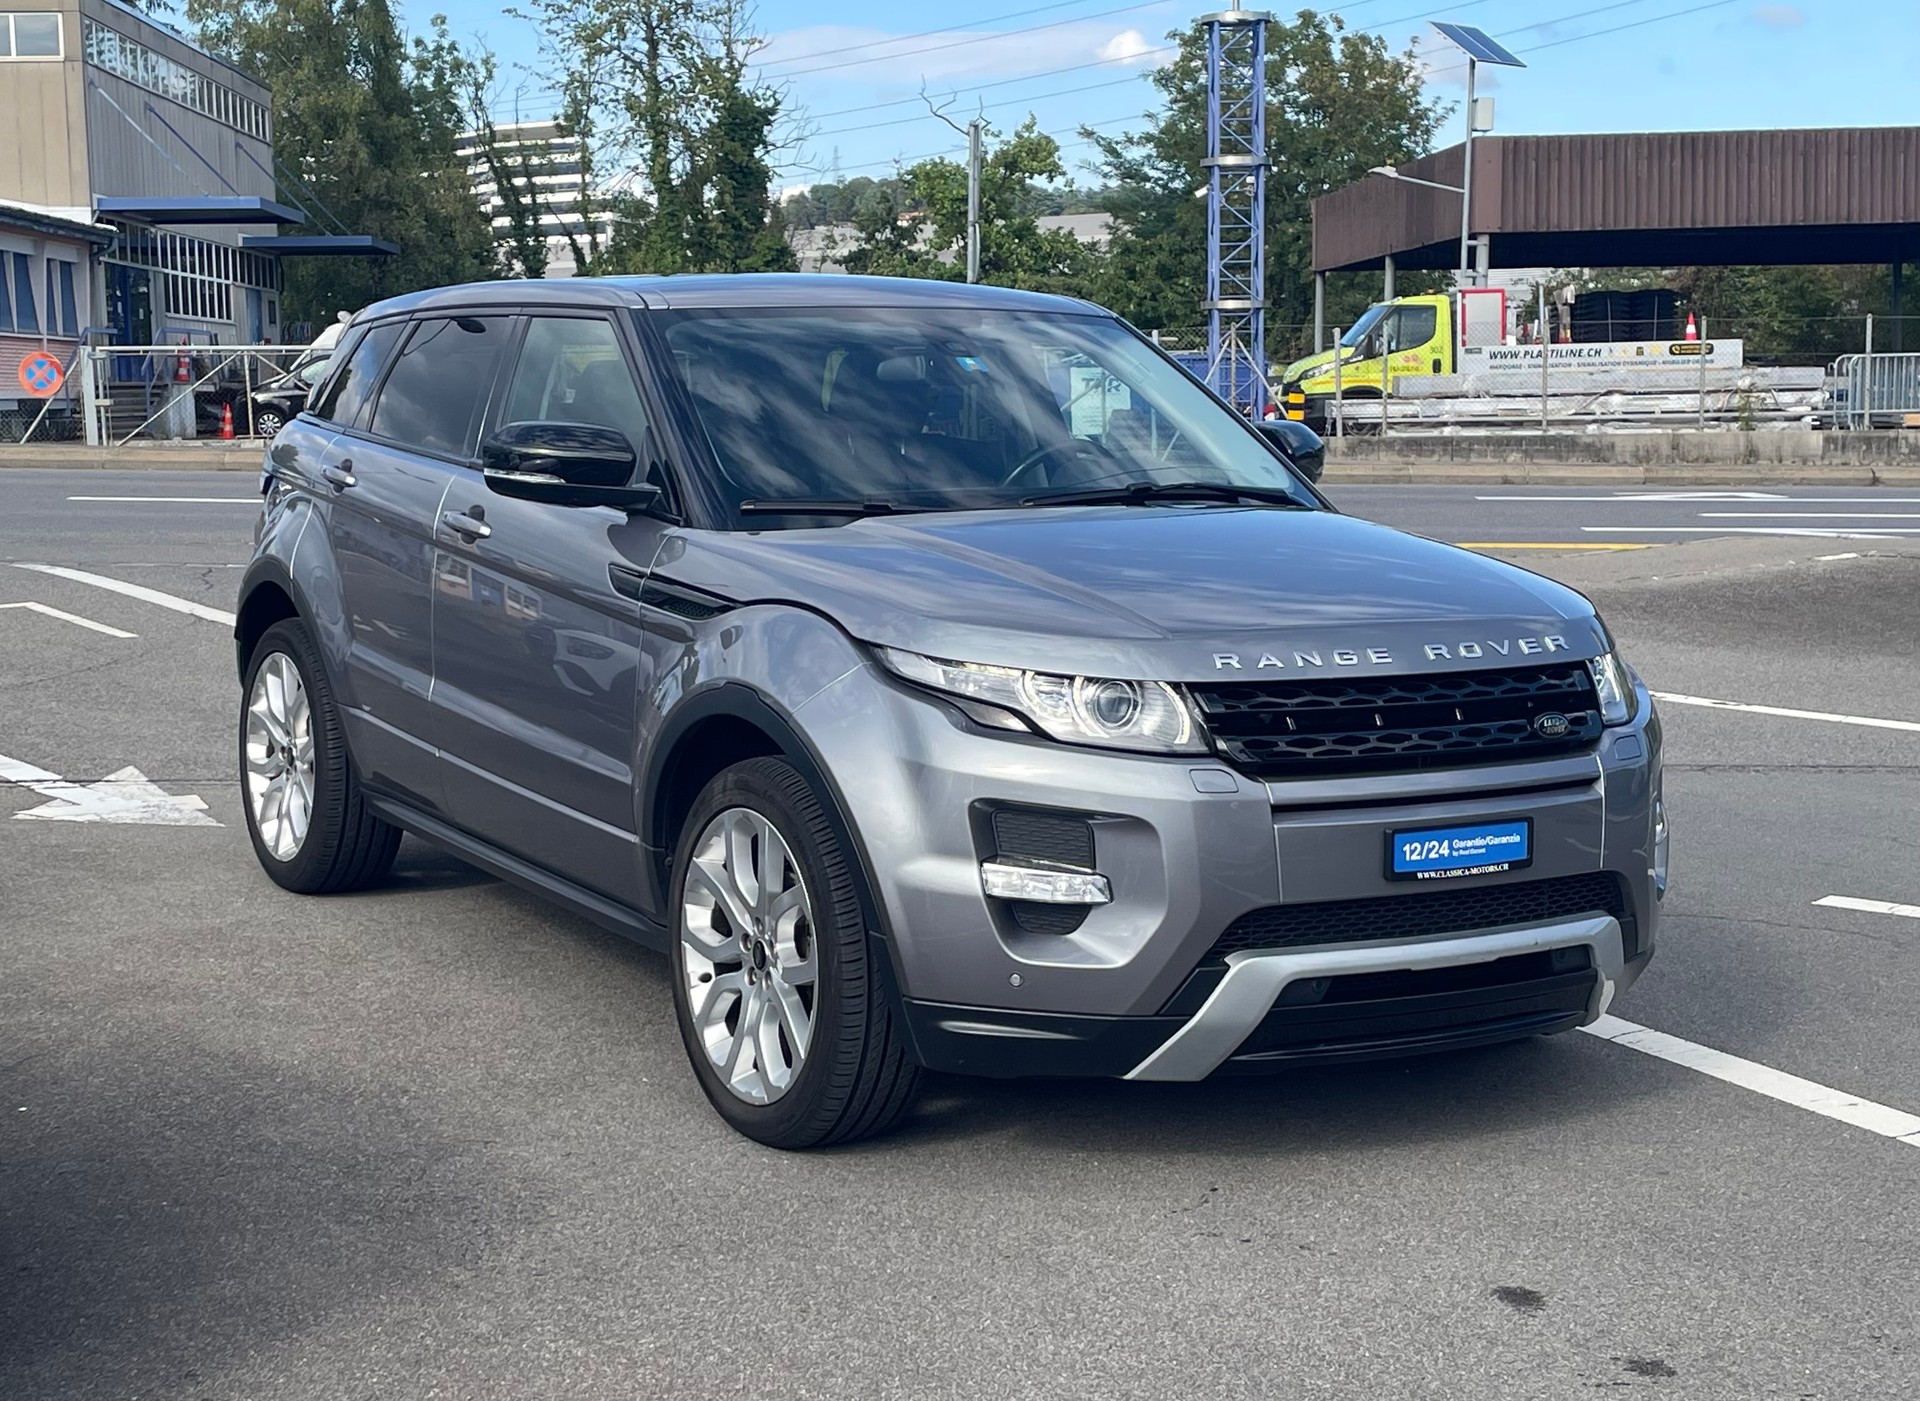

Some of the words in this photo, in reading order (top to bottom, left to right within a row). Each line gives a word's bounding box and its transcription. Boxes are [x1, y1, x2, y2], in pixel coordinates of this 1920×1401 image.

[1489, 348, 1602, 359] WWW.PLATILINE.CH
[1212, 648, 1393, 670] RANGE
[1424, 635, 1570, 661] ROVER
[1402, 839, 1450, 861] 12/24
[1452, 832, 1521, 849] Garantie/Garanzia
[1417, 862, 1509, 879] WWW.CLASSICA-MOTORS.CH
